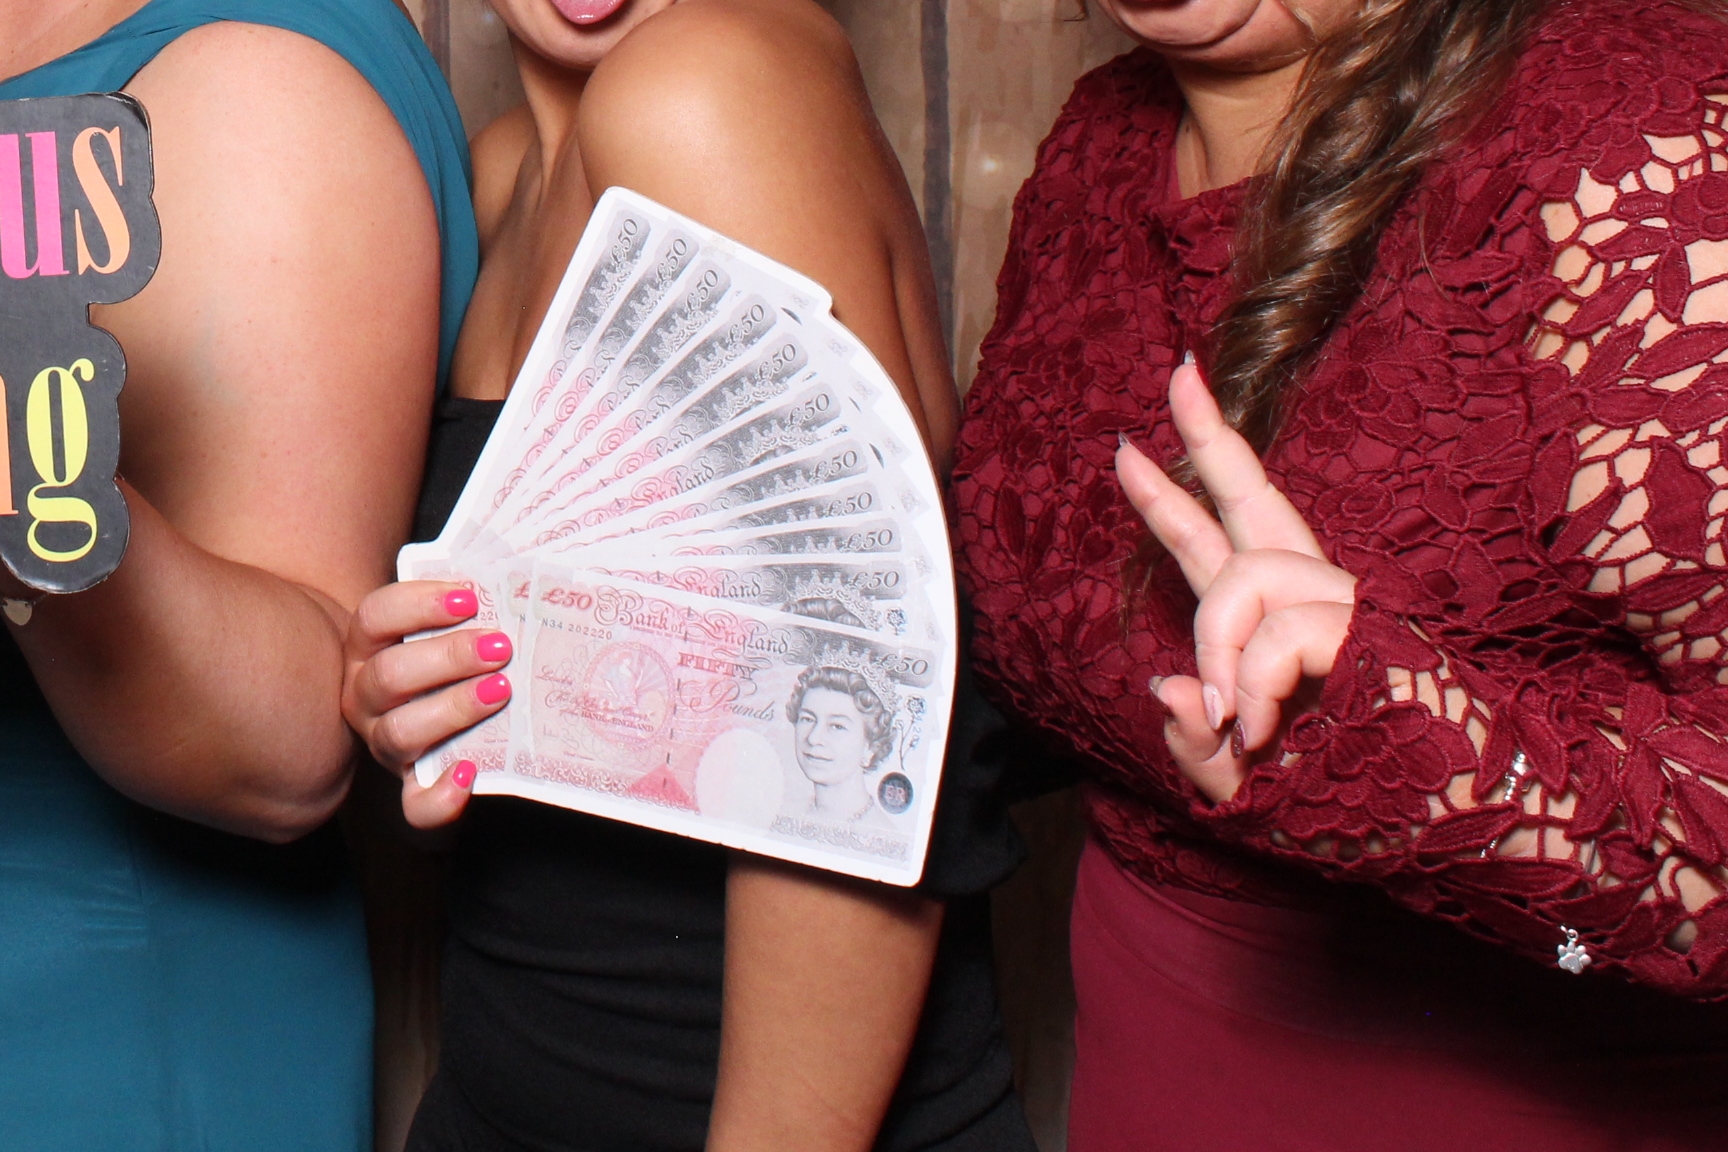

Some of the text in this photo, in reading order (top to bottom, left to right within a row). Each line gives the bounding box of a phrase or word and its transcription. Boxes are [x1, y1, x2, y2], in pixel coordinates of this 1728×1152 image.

[610, 218, 638, 267] £50
[655, 238, 687, 283] £50
[685, 269, 718, 313] £50
[727, 304, 764, 343] £50
[757, 343, 796, 380] £50
[787, 393, 831, 427] £50
[810, 450, 858, 479] £50
[825, 492, 873, 517] £50
[844, 529, 893, 550] £50
[849, 571, 900, 589] £50
[541, 587, 593, 611] £50
[594, 585, 669, 628] Bank
[670, 622, 684, 637] of
[685, 609, 790, 656] England
[677, 652, 759, 681] FIFTY
[875, 652, 929, 677] £50
[679, 677, 775, 722] Pounds
